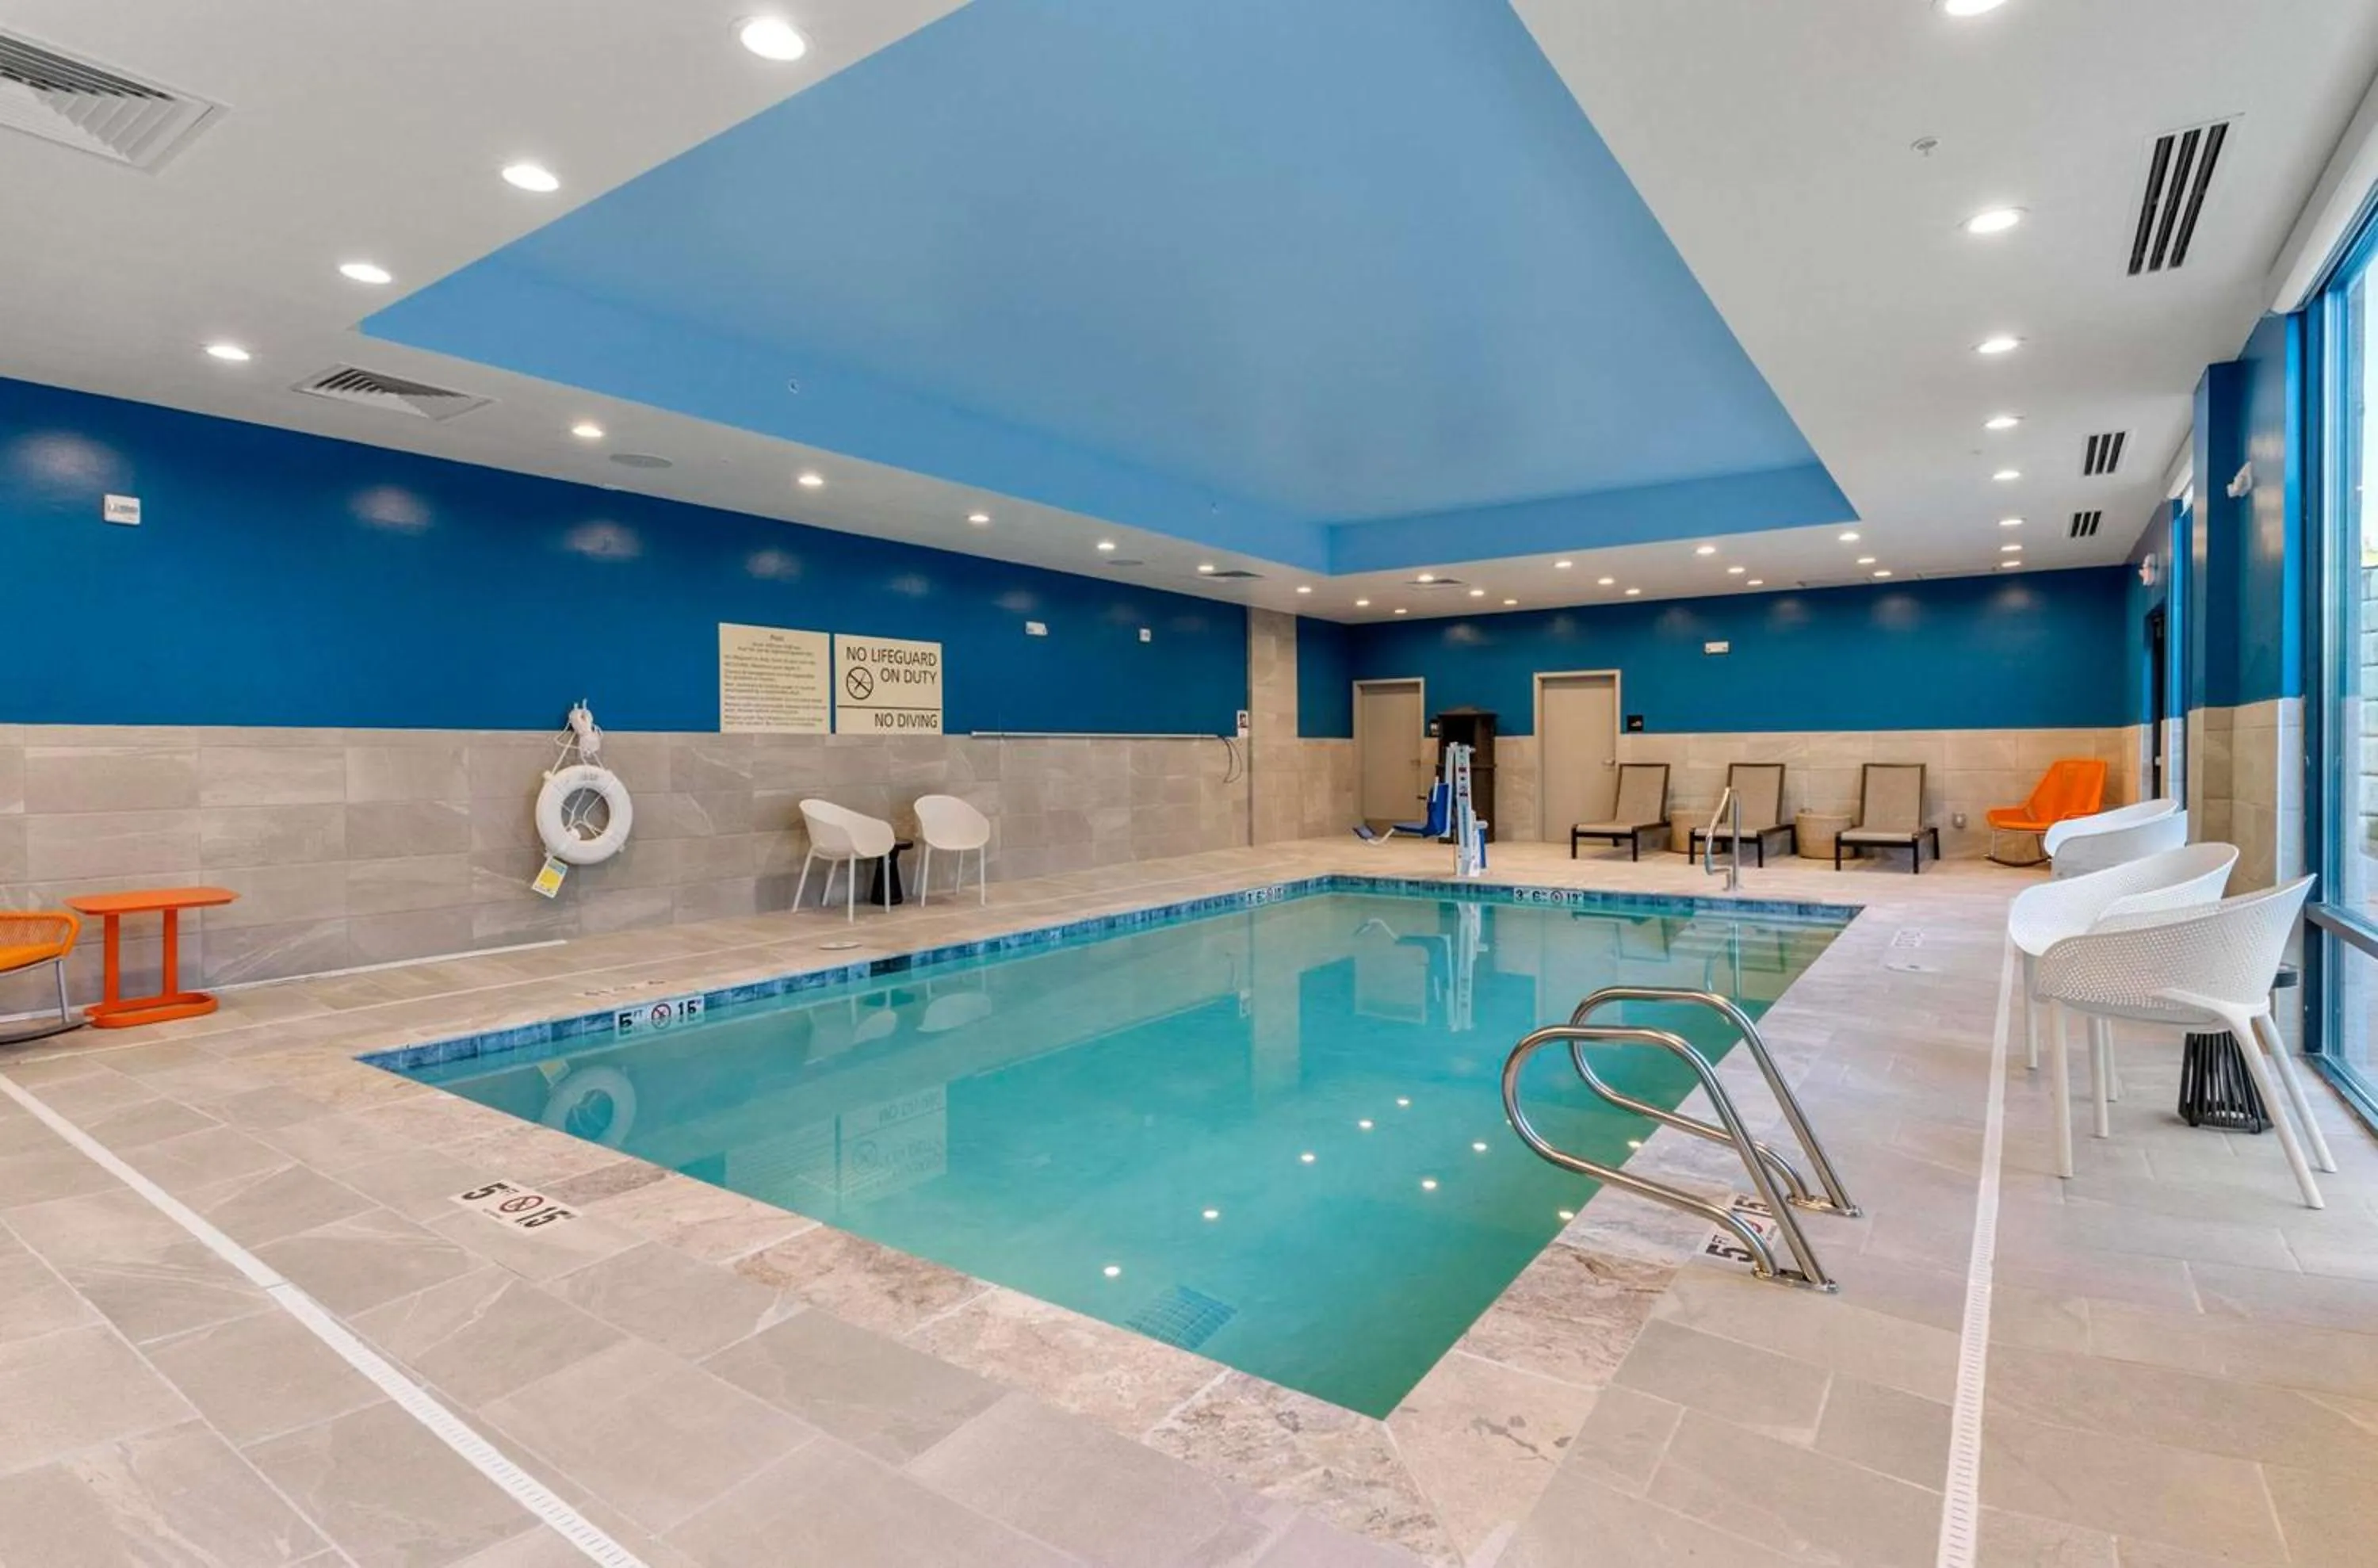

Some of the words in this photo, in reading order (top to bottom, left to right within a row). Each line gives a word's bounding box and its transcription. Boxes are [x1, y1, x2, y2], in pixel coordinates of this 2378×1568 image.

[846, 646, 867, 662] NO
[871, 648, 937, 667] LIFEGUARD
[881, 667, 900, 683] ON
[904, 669, 937, 685] DUTY
[874, 713, 894, 728] NO
[897, 713, 938, 729] DIVING
[618, 1012, 633, 1028] 5
[461, 1182, 510, 1201] 5
